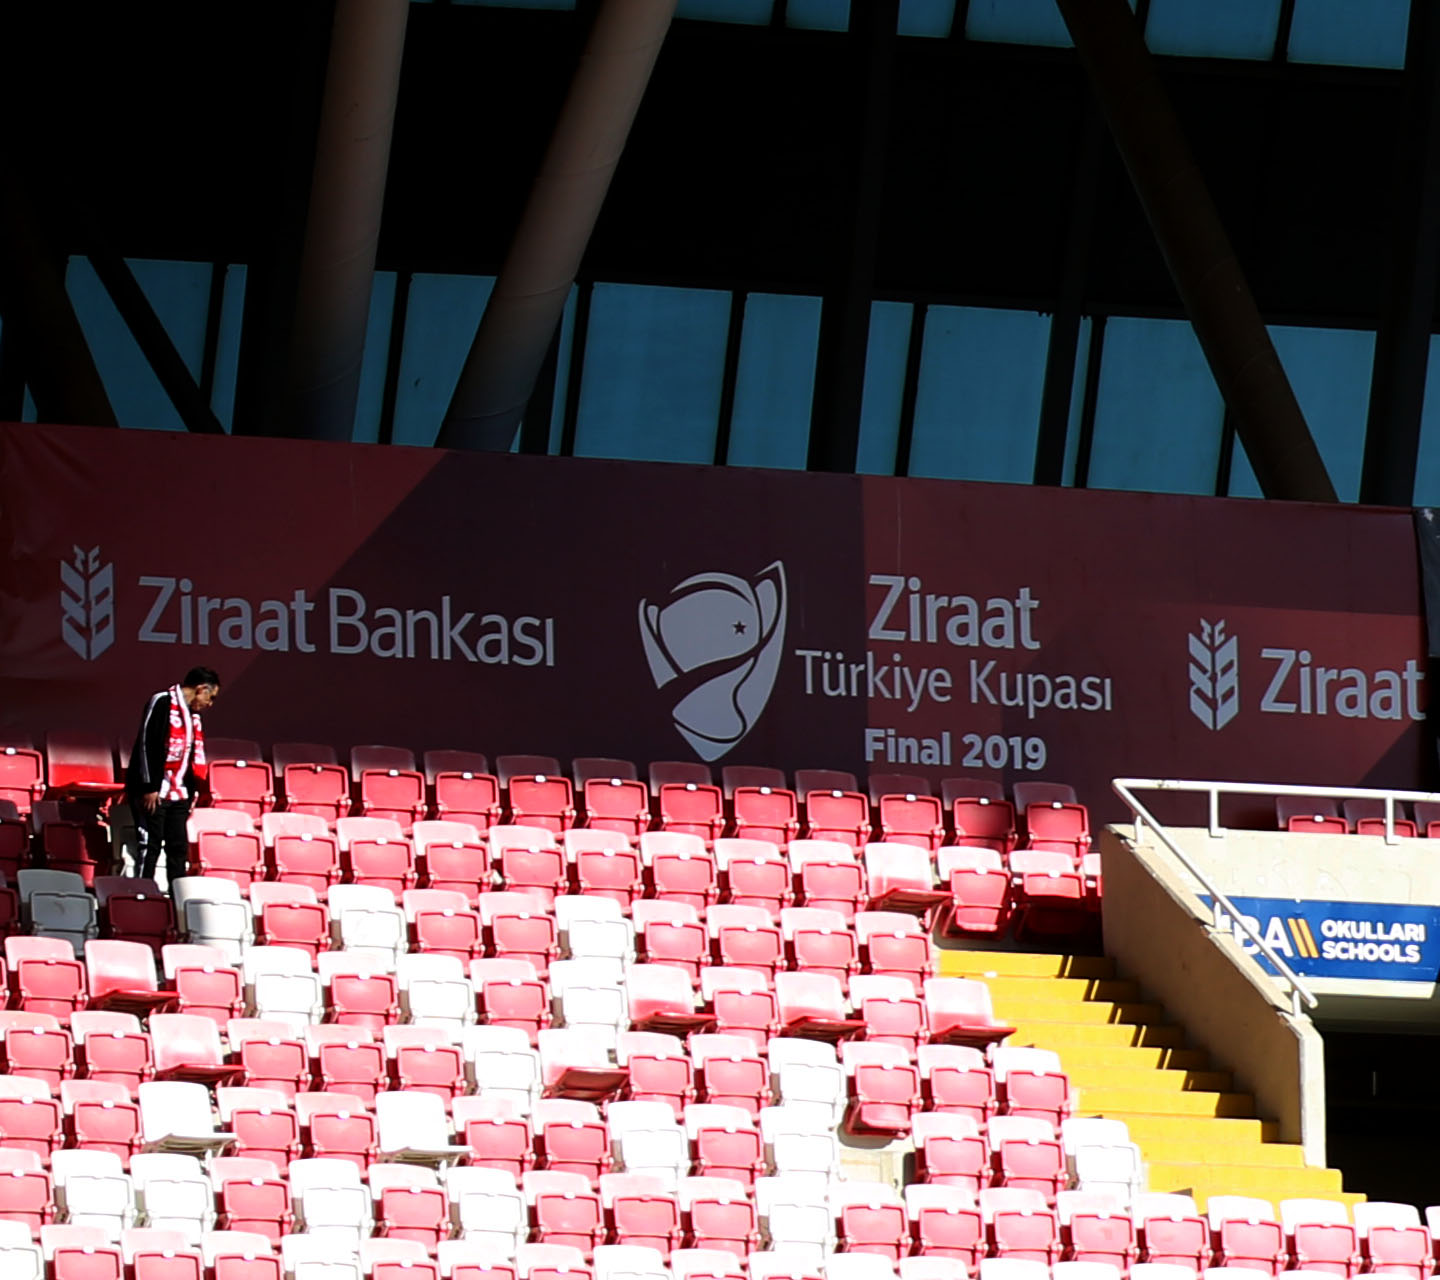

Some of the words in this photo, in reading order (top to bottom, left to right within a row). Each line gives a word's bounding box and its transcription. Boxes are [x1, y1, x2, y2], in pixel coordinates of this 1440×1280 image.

[137, 575, 317, 653] Ziraat
[328, 587, 556, 667] Bankası
[867, 573, 1041, 651] Ziraat
[795, 648, 953, 713] Türkiye
[970, 659, 1113, 720] Kupası
[1259, 647, 1427, 722] Ziraat
[864, 728, 951, 767] Final
[962, 732, 1047, 771] 2019
[1321, 920, 1425, 942] OKULLARI
[1322, 941, 1421, 963] SCHOOLS
